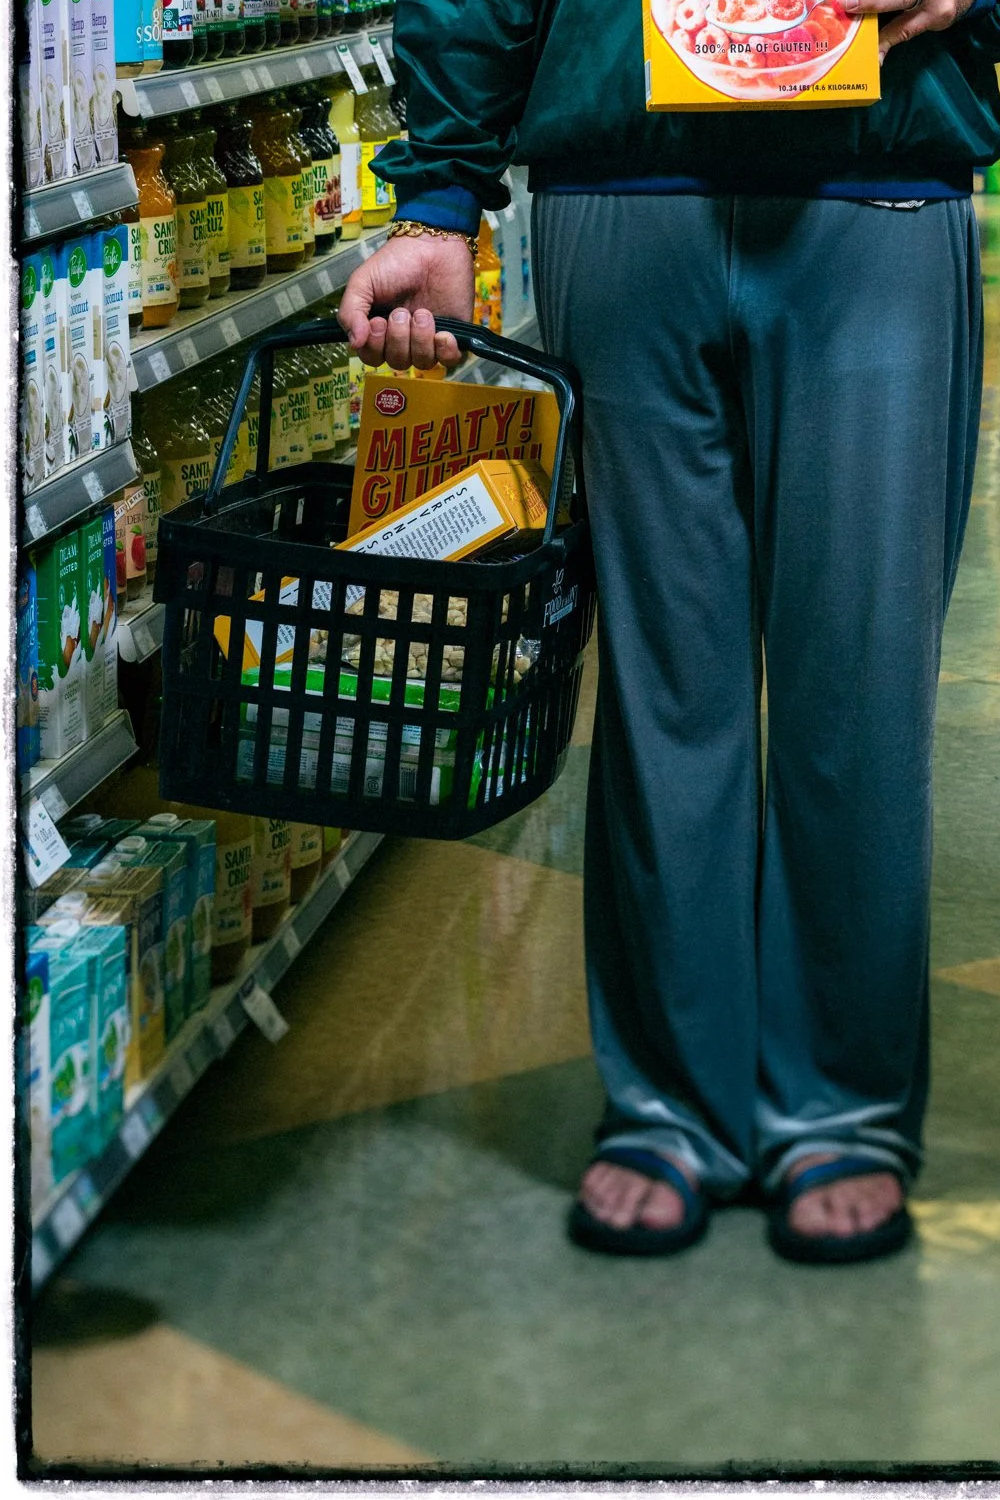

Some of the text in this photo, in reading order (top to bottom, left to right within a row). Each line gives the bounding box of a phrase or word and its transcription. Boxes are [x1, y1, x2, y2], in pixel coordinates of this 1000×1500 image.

[91, 12, 107, 29] Hemp
[695, 41, 829, 54] 300% RDA OF GLUTEN !!!
[812, 84, 826, 92] (4.6
[158, 239, 176, 256] CRU
[364, 397, 536, 471] MEATY!
